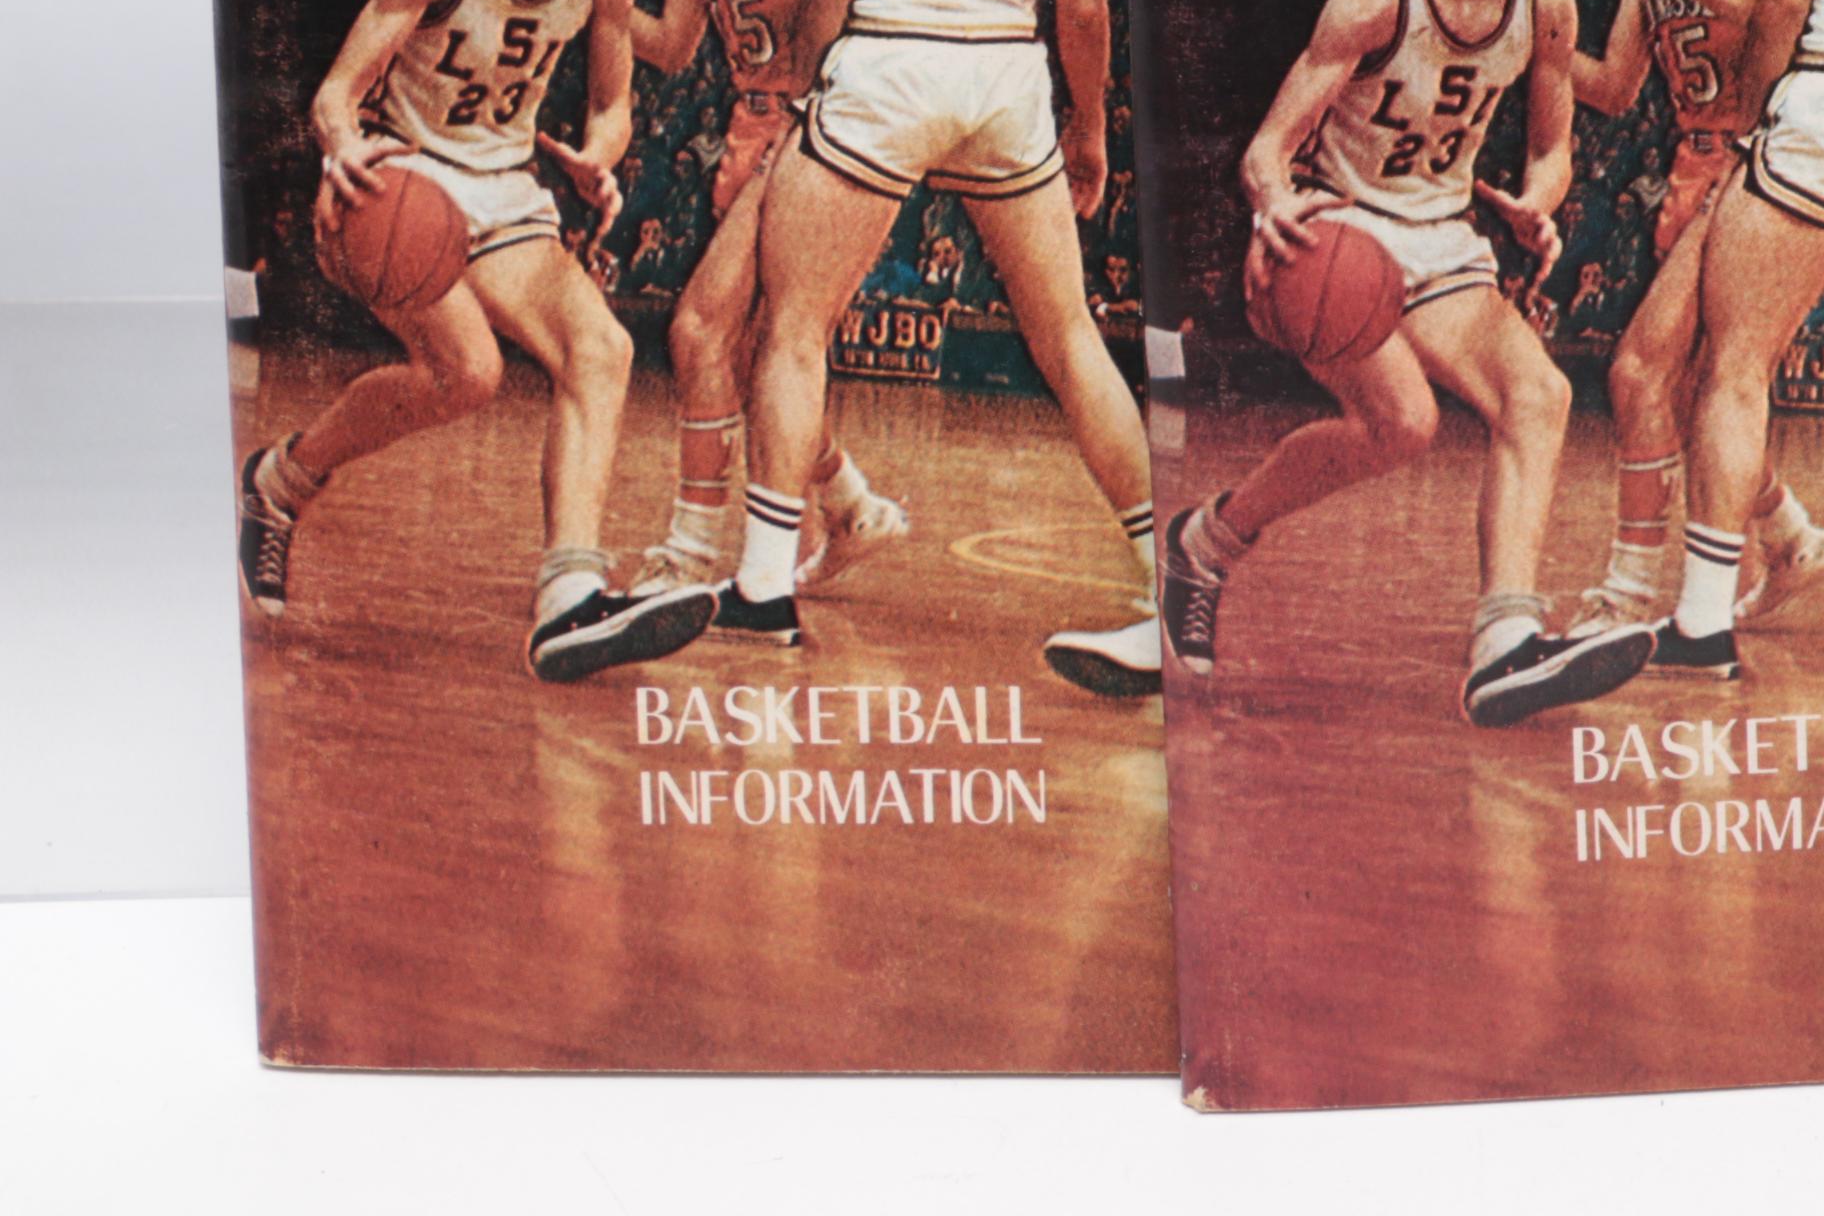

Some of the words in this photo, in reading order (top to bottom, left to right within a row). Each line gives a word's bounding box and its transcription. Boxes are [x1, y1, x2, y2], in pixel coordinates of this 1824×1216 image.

[446, 80, 530, 126] 23
[1379, 127, 1468, 178] 23
[635, 684, 1043, 746] BASKETBALL
[639, 768, 1047, 825] INFORMATION
